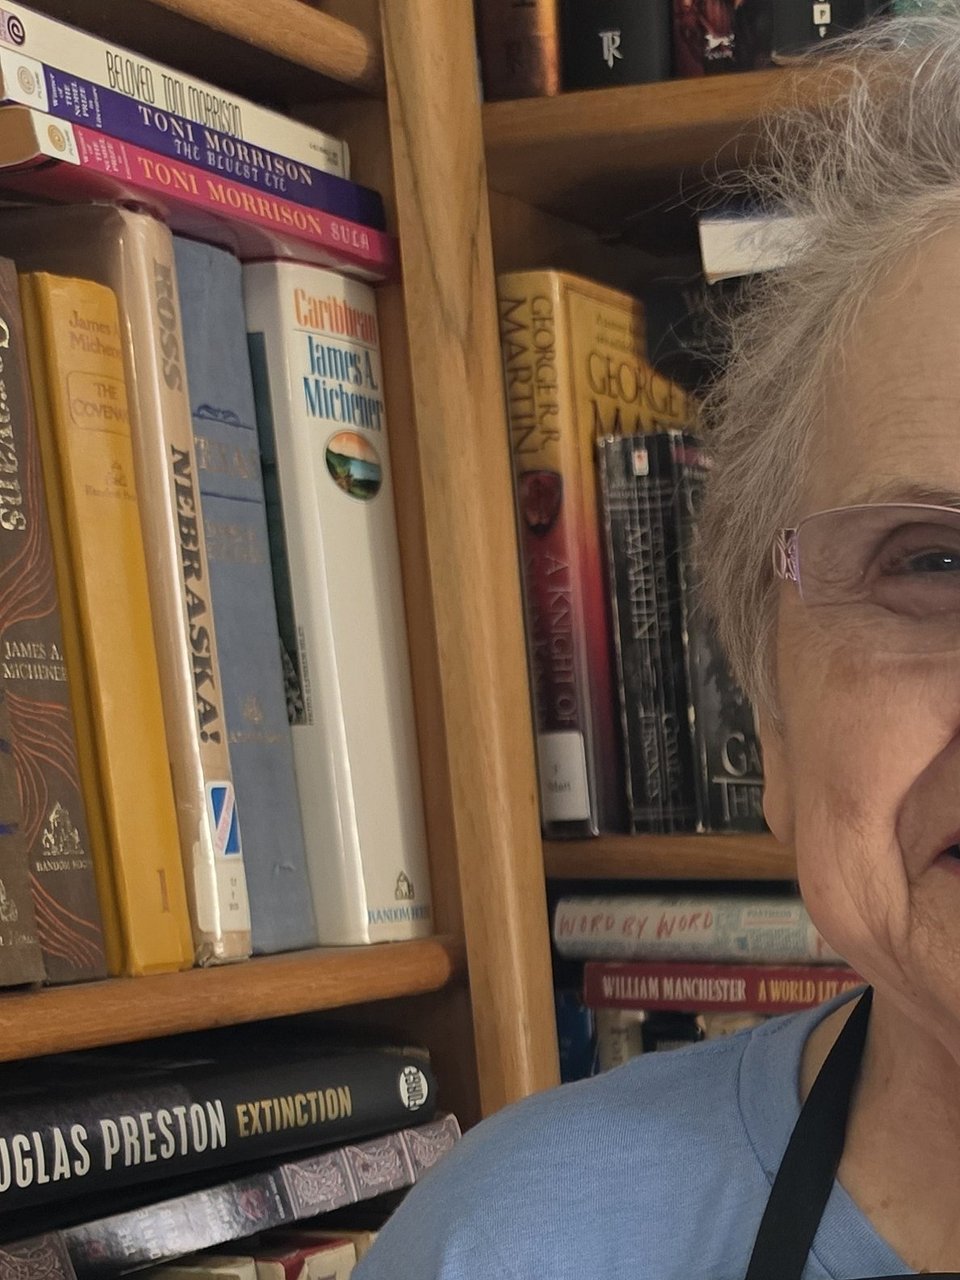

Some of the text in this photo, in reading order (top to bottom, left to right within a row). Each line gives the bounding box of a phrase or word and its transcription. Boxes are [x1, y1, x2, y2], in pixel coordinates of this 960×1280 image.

[64, 84, 72, 106] THE
[71, 82, 81, 117] NOBEL
[79, 86, 89, 118] PRIZE
[106, 50, 244, 140] BELOVED TONI MORRISON
[138, 105, 194, 142] TONI
[205, 130, 313, 187] MORRISON
[174, 139, 287, 192] THE BLUEST EYE
[137, 156, 199, 195] TONI
[207, 180, 323, 235] MORRISON
[330, 221, 370, 251] SULA
[293, 287, 377, 346] Caribbean
[307, 335, 378, 391] James A.
[529, 295, 559, 398] GEORGE
[93, 381, 118, 400] THE
[303, 376, 384, 433] Michener
[501, 297, 540, 457] MARTIN
[171, 443, 222, 745] NEBRASKA!
[545, 555, 569, 577] A
[5, 641, 46, 659] JAMES
[550, 589, 576, 683] KNIGHT
[559, 910, 714, 940] WORD BY WORD
[602, 975, 660, 1000] WILLIAM
[662, 976, 747, 1002] MANCHESTER
[758, 980, 768, 1002] A
[770, 980, 815, 1002] WORLD
[402, 1065, 424, 1111] FORGE
[100, 1099, 228, 1171] PRESTON
[236, 1085, 353, 1138] EXTINCTION
